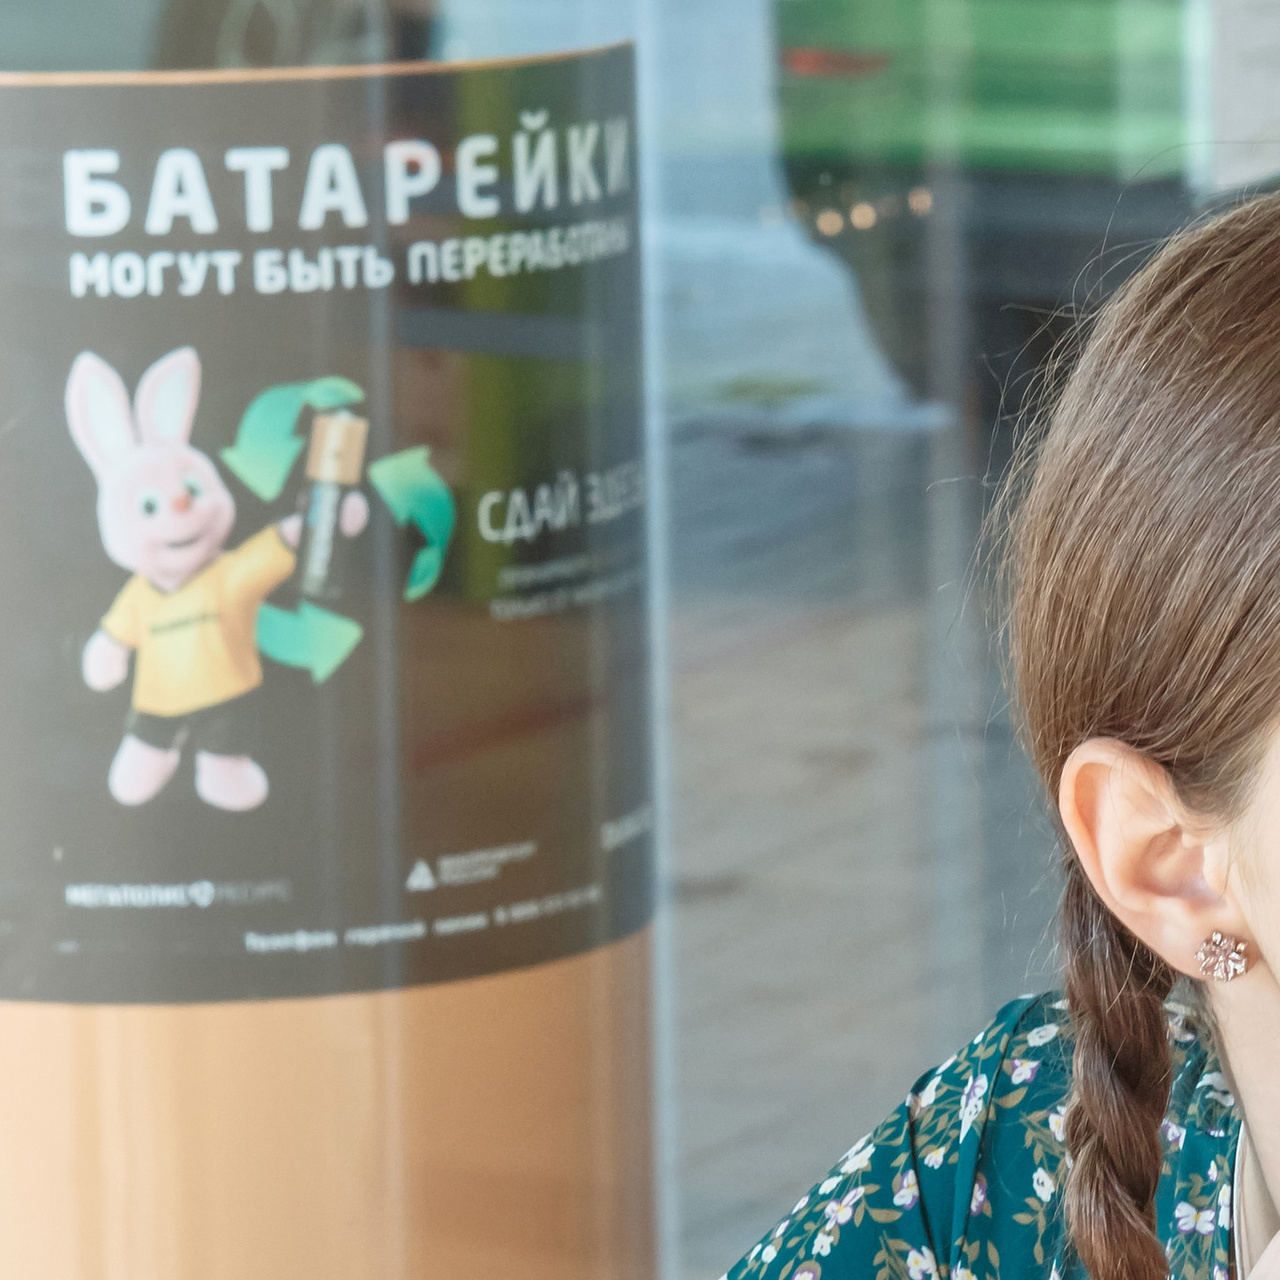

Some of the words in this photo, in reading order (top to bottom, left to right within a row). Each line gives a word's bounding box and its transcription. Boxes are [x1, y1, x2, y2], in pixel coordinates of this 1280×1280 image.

[62, 108, 630, 237] БАТАРЕЙКИ
[69, 250, 242, 298] МОГУТ
[253, 244, 396, 296] БЫТЬ
